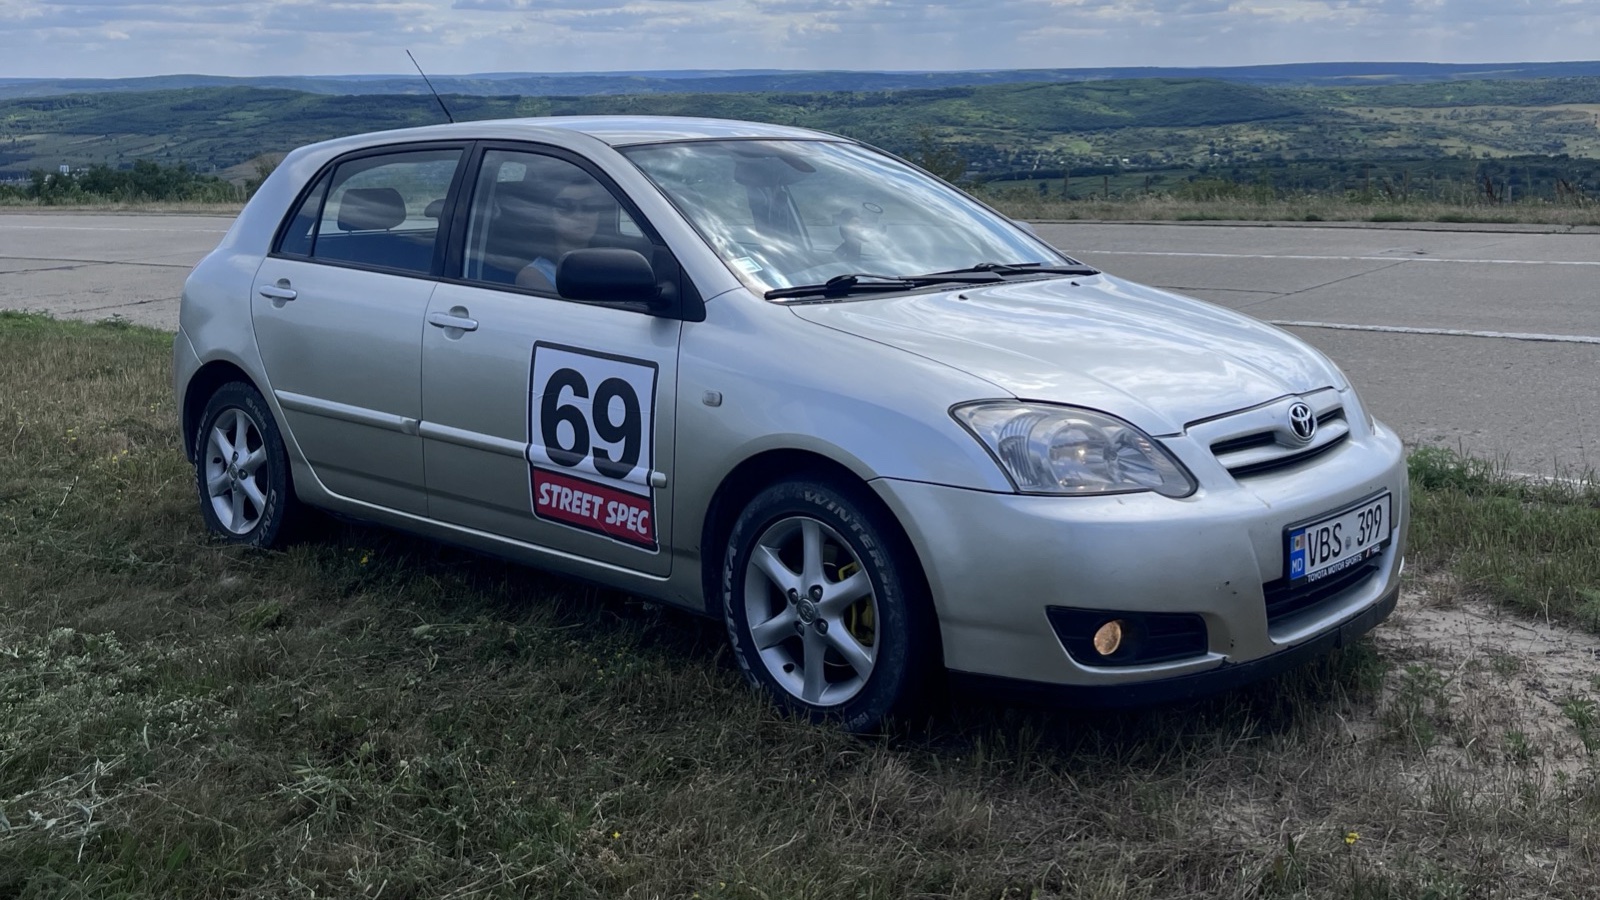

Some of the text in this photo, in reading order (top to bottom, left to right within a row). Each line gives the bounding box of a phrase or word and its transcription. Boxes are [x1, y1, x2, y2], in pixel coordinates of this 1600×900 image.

[541, 368, 641, 479] 69
[538, 483, 650, 534] STREET SPEC
[804, 490, 885, 568] WINTER
[1307, 504, 1382, 567] VBS 399
[1291, 558, 1303, 574] MD
[1307, 553, 1362, 582] TOYOTA MOTOR SPORTS
